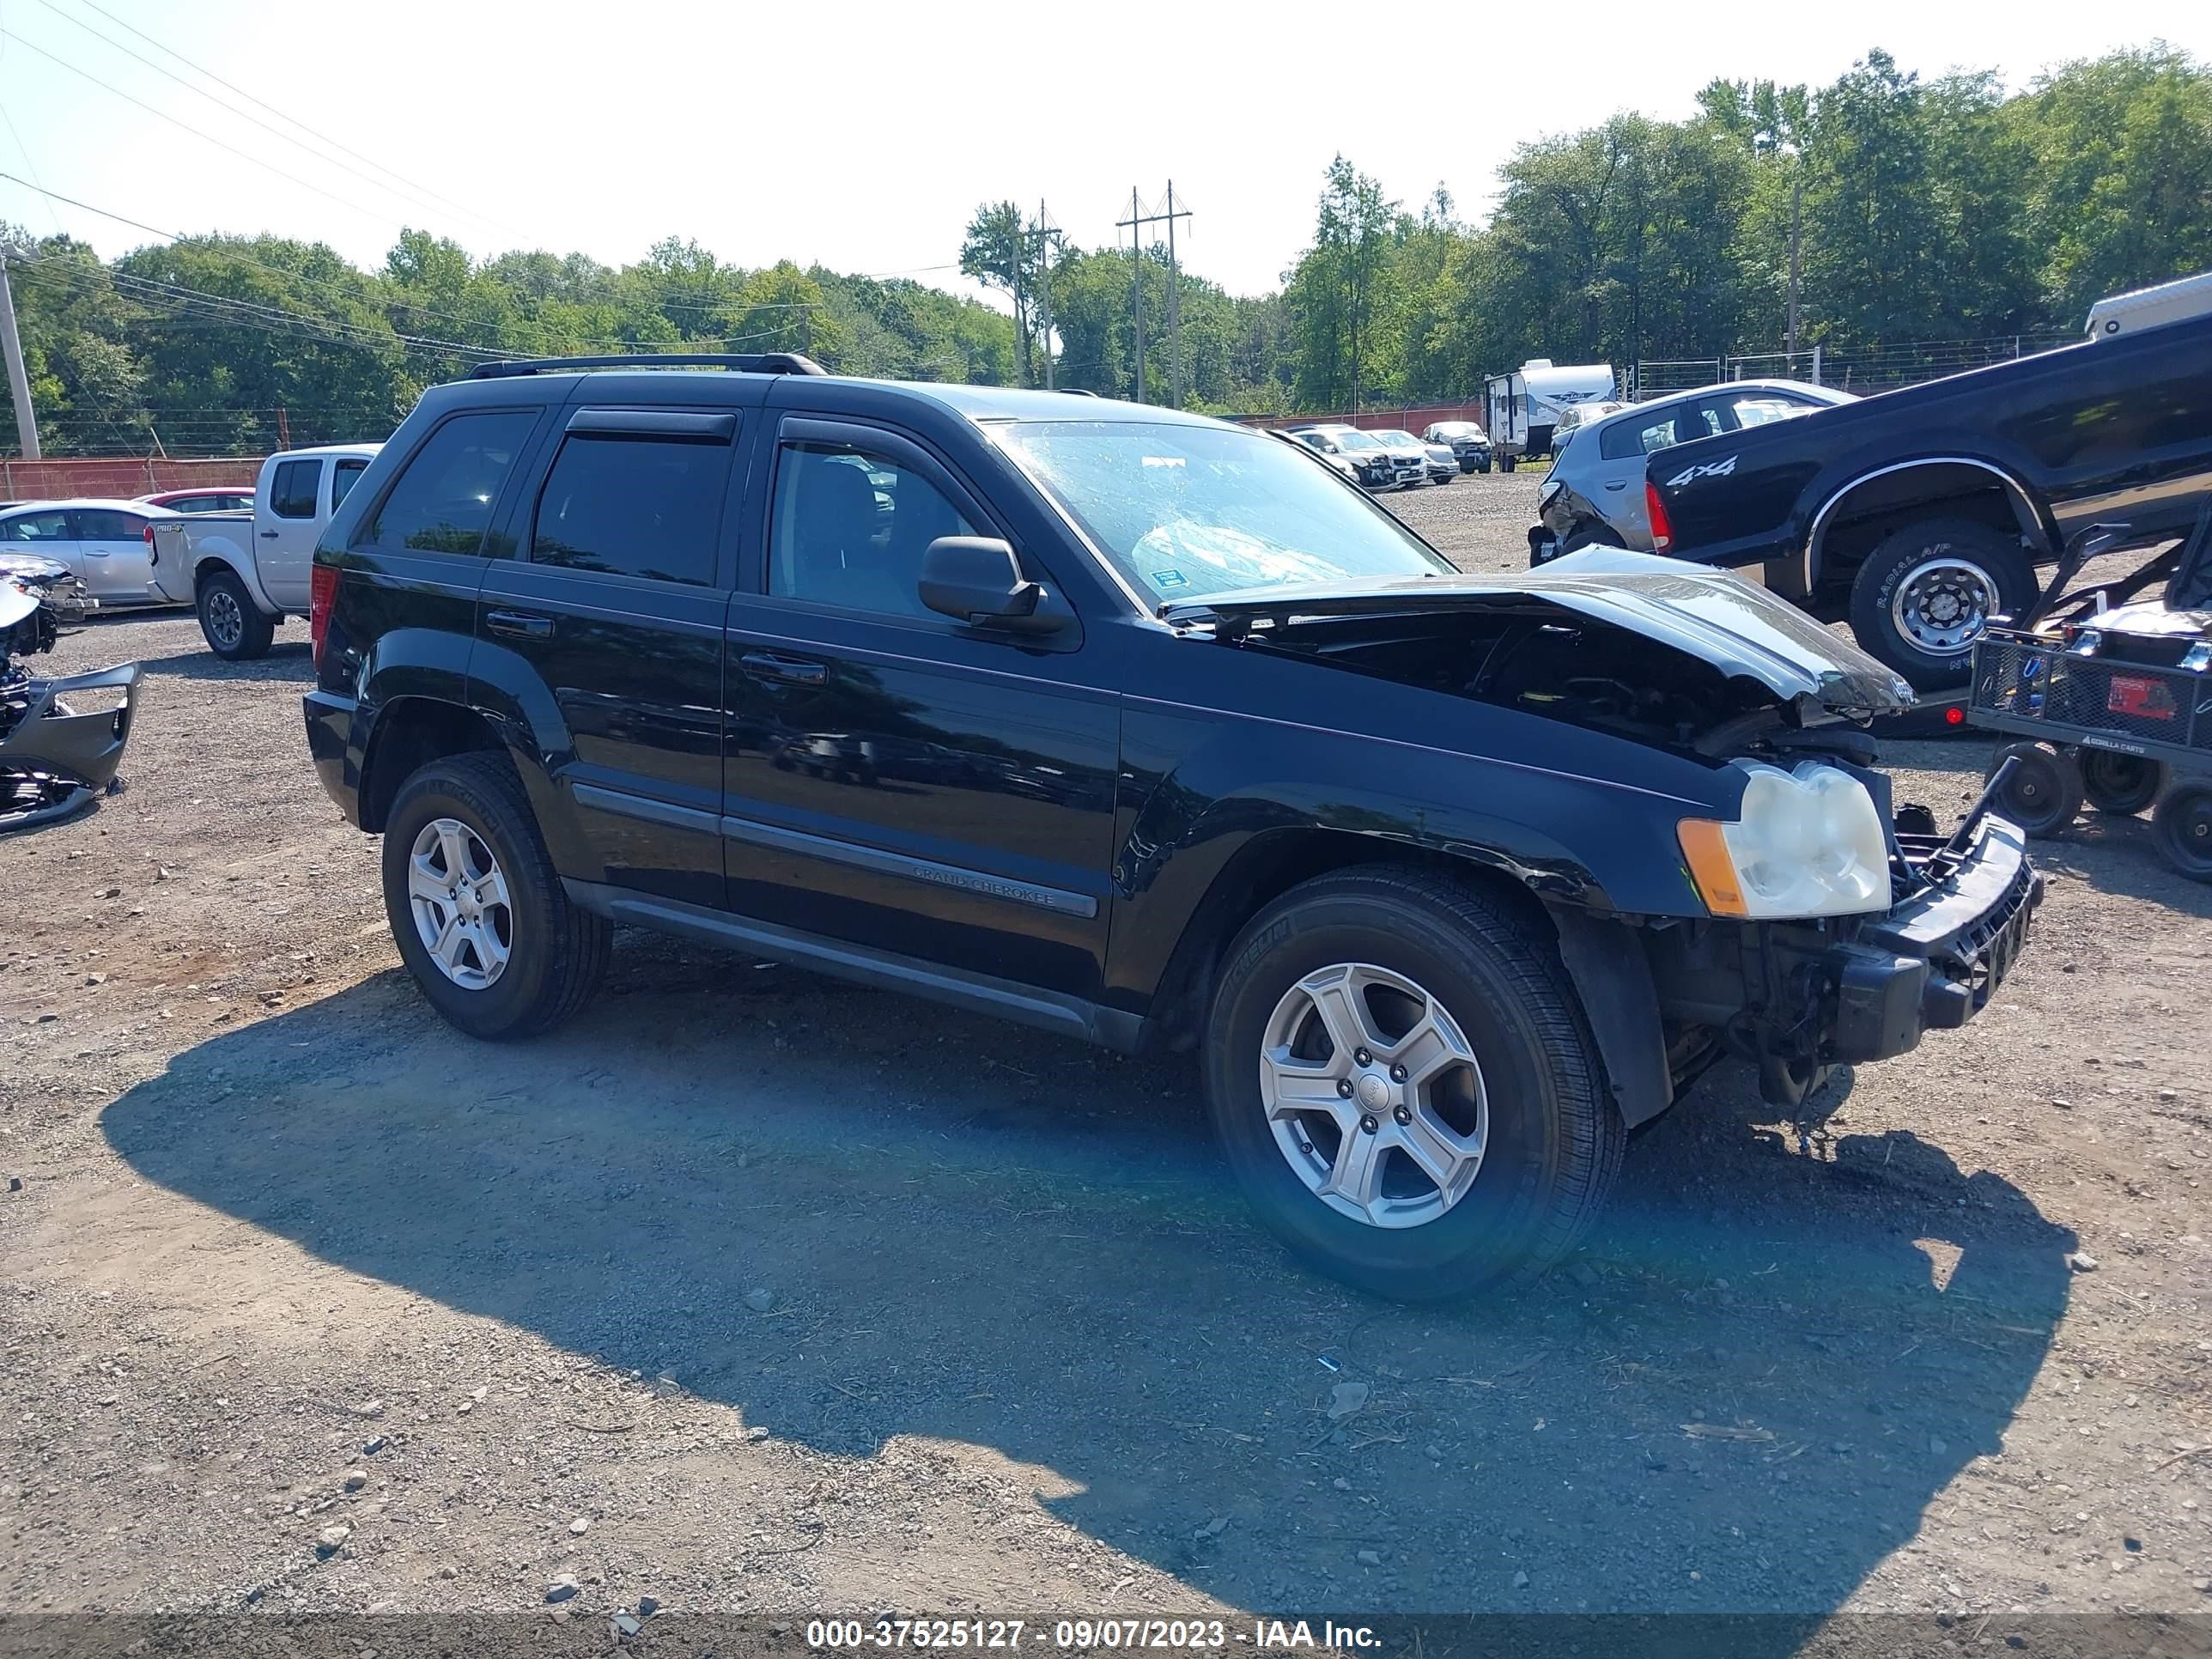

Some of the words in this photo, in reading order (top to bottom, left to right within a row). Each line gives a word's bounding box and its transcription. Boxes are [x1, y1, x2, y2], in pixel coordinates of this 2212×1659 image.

[1875, 555, 1917, 609] RADIAL
[2090, 738, 2120, 749] GORILLA
[2120, 743, 2144, 754] CARTS
[913, 866, 967, 887] GRAND
[971, 878, 1055, 905] CHEROKEE
